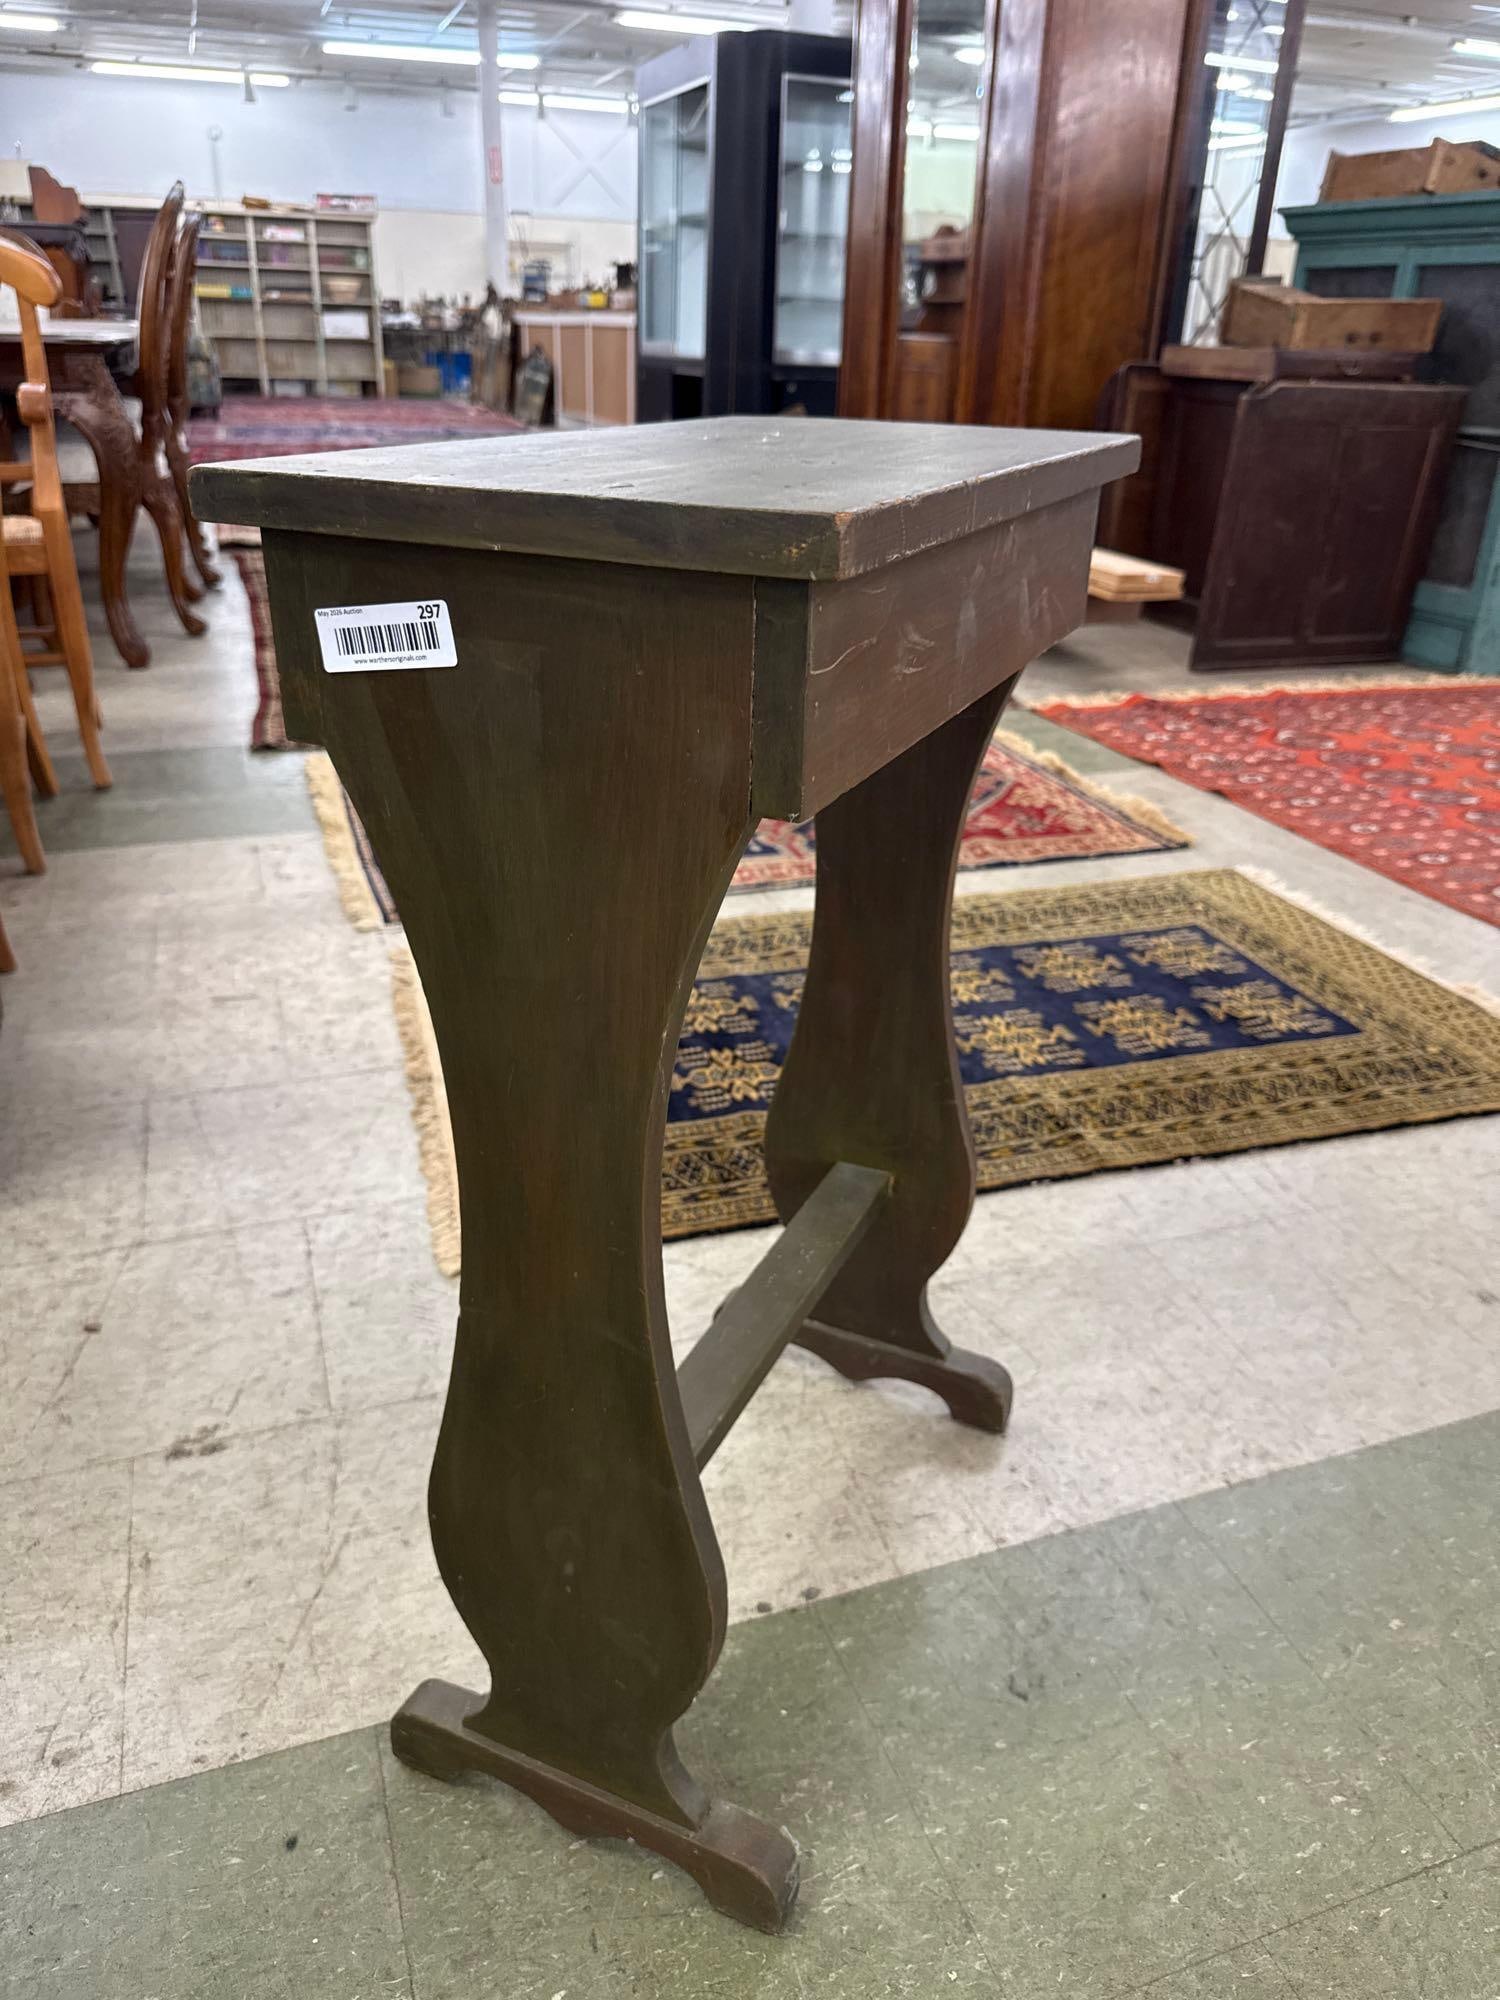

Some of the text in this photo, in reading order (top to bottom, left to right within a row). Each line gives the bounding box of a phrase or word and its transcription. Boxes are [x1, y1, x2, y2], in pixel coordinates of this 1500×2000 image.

[317, 610, 329, 618] May
[329, 609, 342, 617] 2026
[417, 604, 440, 619] 297
